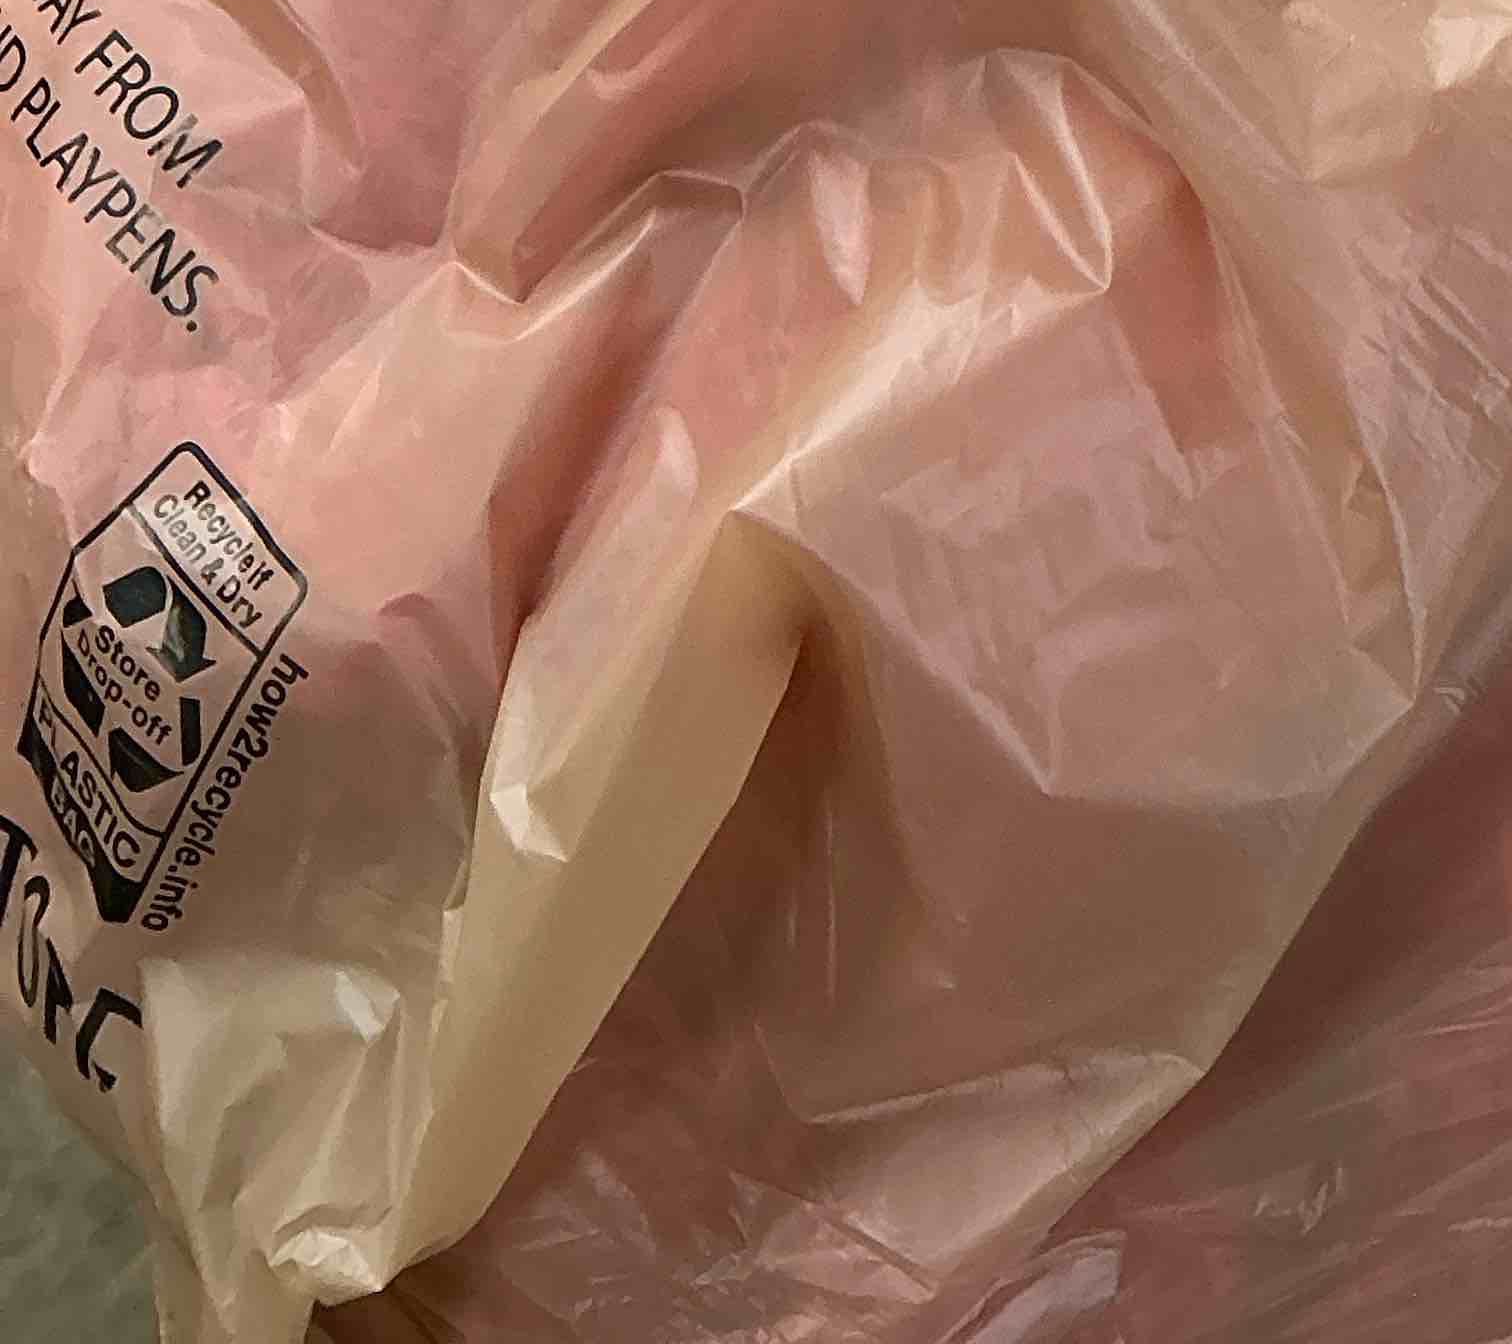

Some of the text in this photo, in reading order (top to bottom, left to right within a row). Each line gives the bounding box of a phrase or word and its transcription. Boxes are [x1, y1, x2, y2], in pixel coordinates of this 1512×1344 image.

[74, 28, 223, 189] FROM
[10, 76, 219, 333] PLAYPENS.
[153, 493, 263, 629] Clean & Dry
[183, 479, 255, 573] Recycle
[77, 628, 173, 746] Drop-off
[94, 625, 161, 702] Store
[141, 653, 309, 934] how2recycle.info
